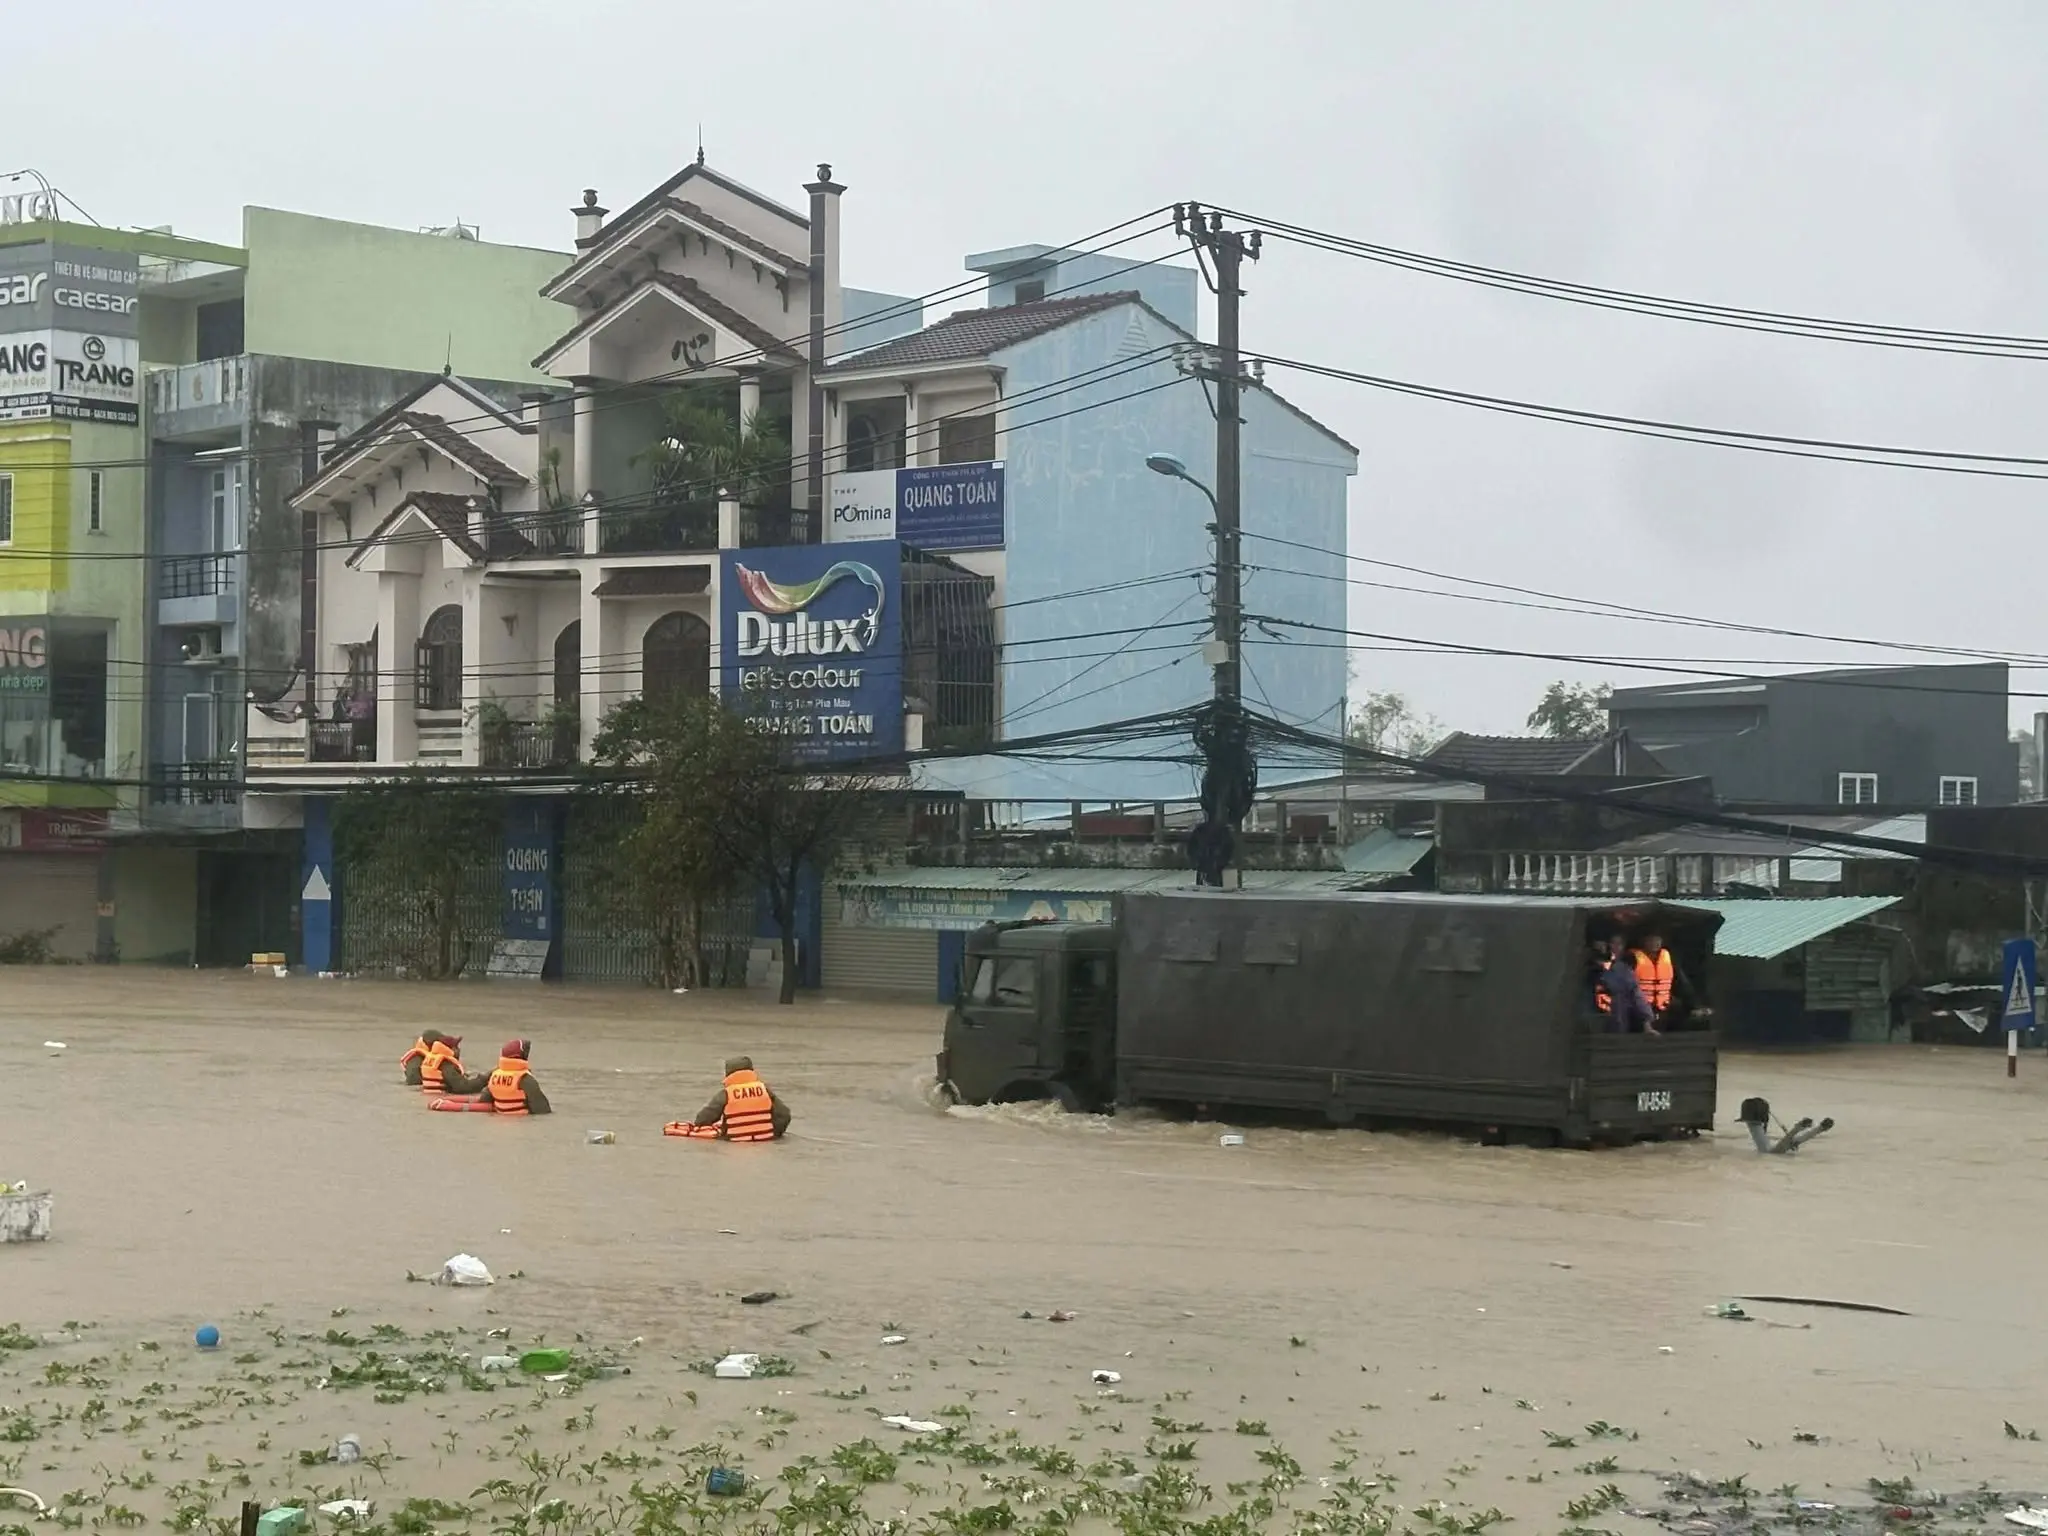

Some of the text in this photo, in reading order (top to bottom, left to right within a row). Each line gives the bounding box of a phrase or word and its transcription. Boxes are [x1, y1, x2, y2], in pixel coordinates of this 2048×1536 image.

[54, 287, 138, 314] caesar
[54, 358, 134, 391] TRANG
[904, 477, 997, 512] QUANG TOÁN
[737, 611, 865, 657] Dulux
[788, 664, 866, 689] colour
[507, 847, 548, 872] QUANG
[492, 1074, 514, 1087] CAND
[733, 1086, 764, 1099] CAND
